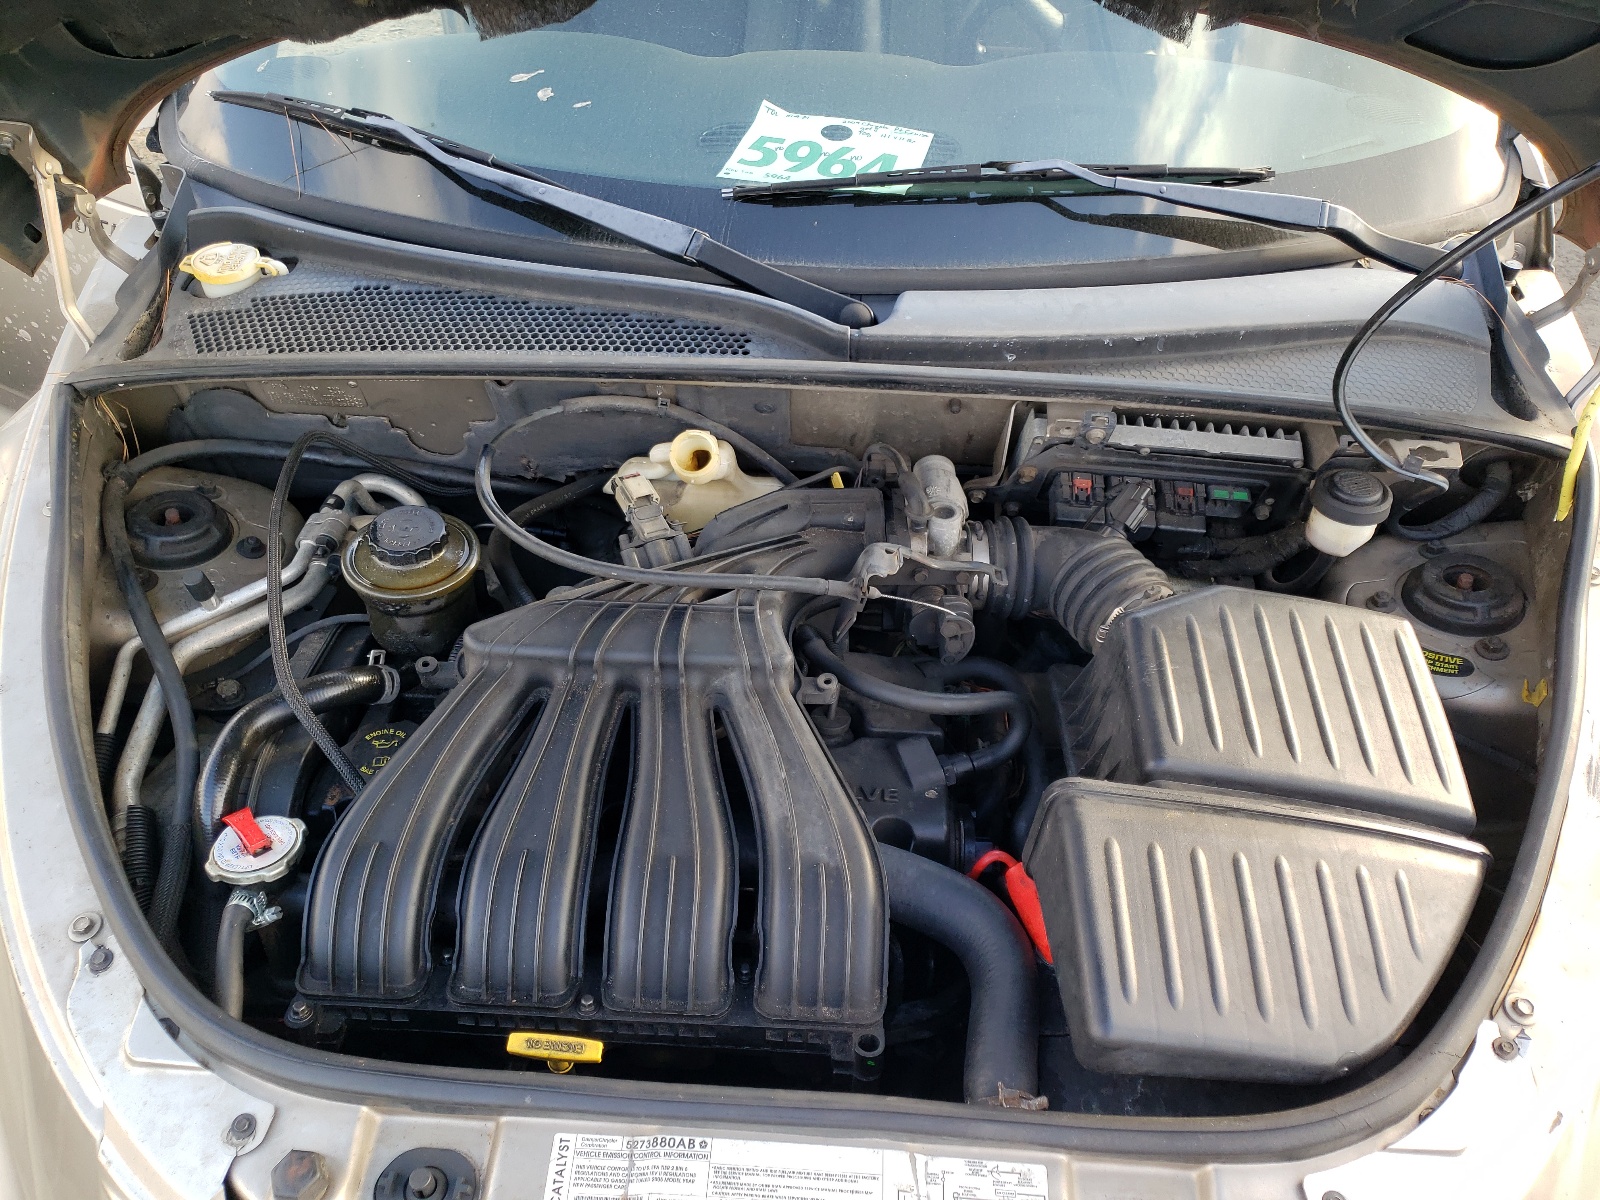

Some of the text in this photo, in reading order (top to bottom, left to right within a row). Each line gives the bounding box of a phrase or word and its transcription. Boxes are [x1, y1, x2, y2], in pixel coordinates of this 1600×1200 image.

[1422, 650, 1464, 664] OSITIVE
[365, 728, 406, 740] ENGINE OIL
[626, 1137, 696, 1149] 5273880AB
[634, 1151, 662, 1159] CONTROL
[664, 1152, 708, 1160] INFORMATION
